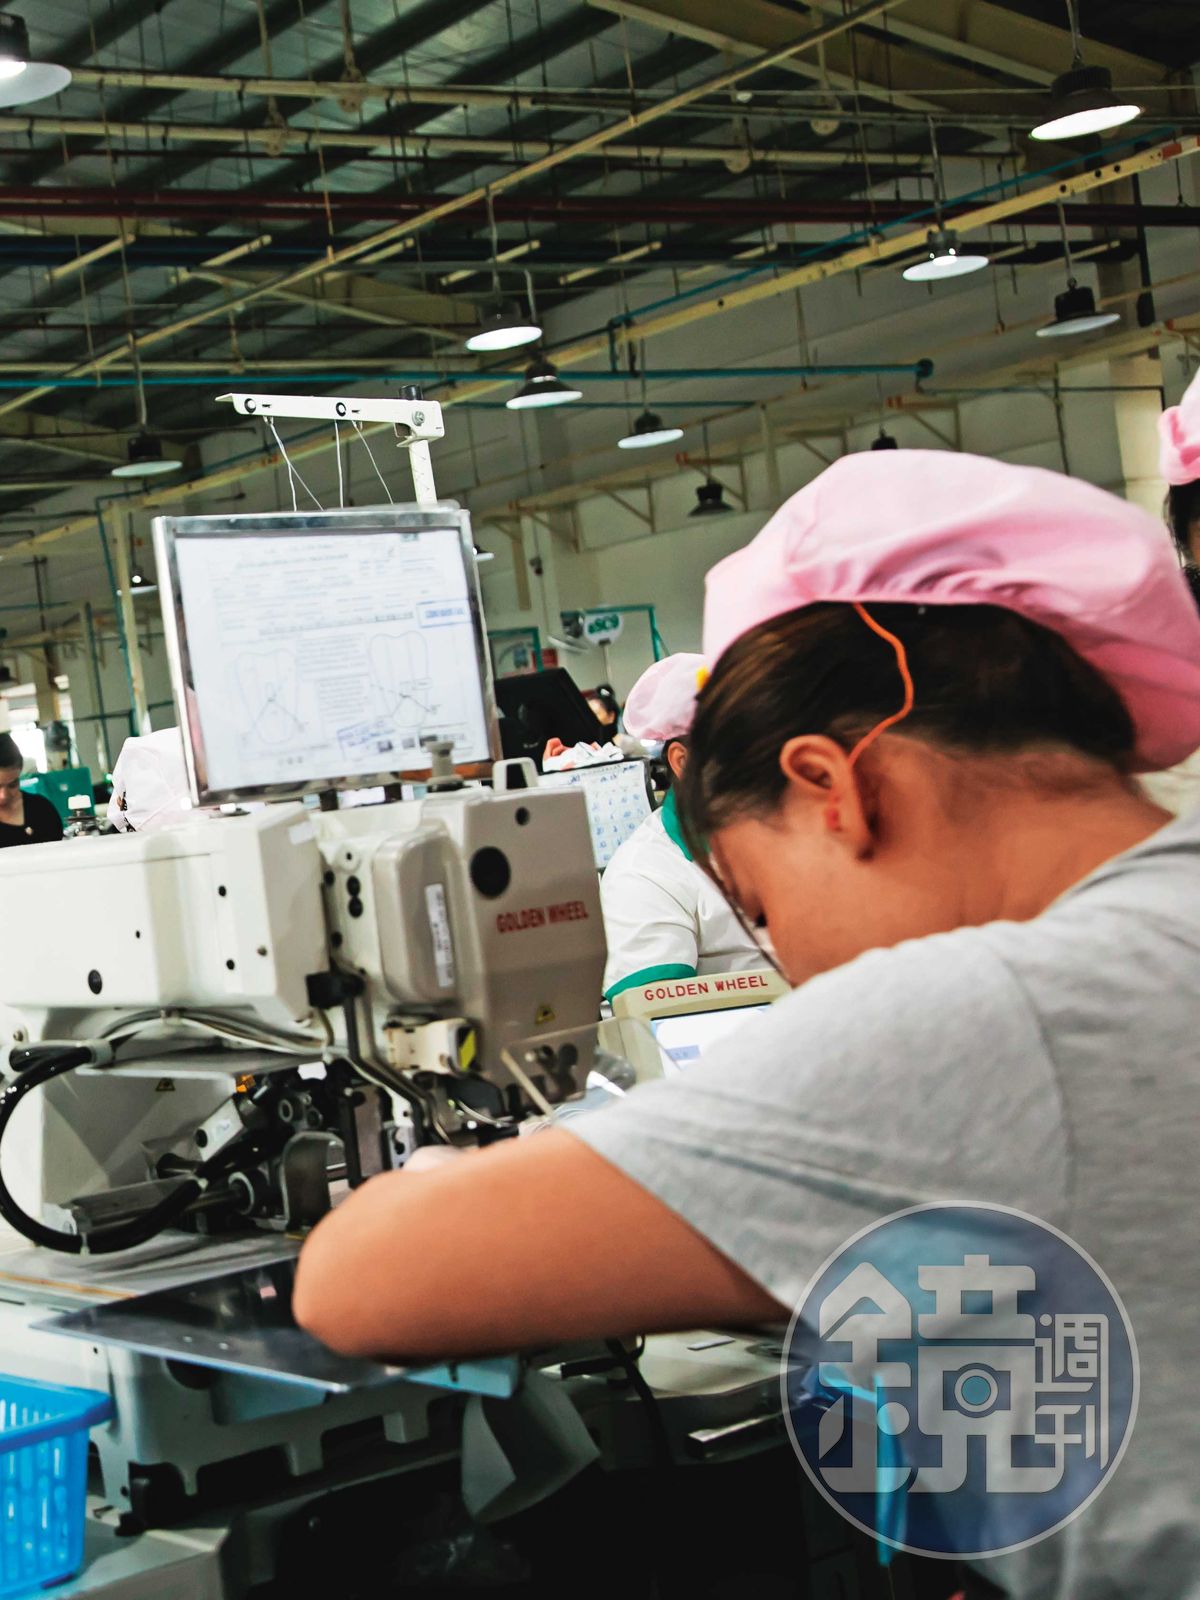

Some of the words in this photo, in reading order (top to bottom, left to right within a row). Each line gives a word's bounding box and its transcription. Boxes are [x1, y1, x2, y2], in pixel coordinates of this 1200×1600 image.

[496, 907, 545, 933] GOLDEN
[548, 901, 588, 923] WHEEL
[644, 982, 709, 1001] GOLDEN
[714, 975, 768, 992] WHEEL
